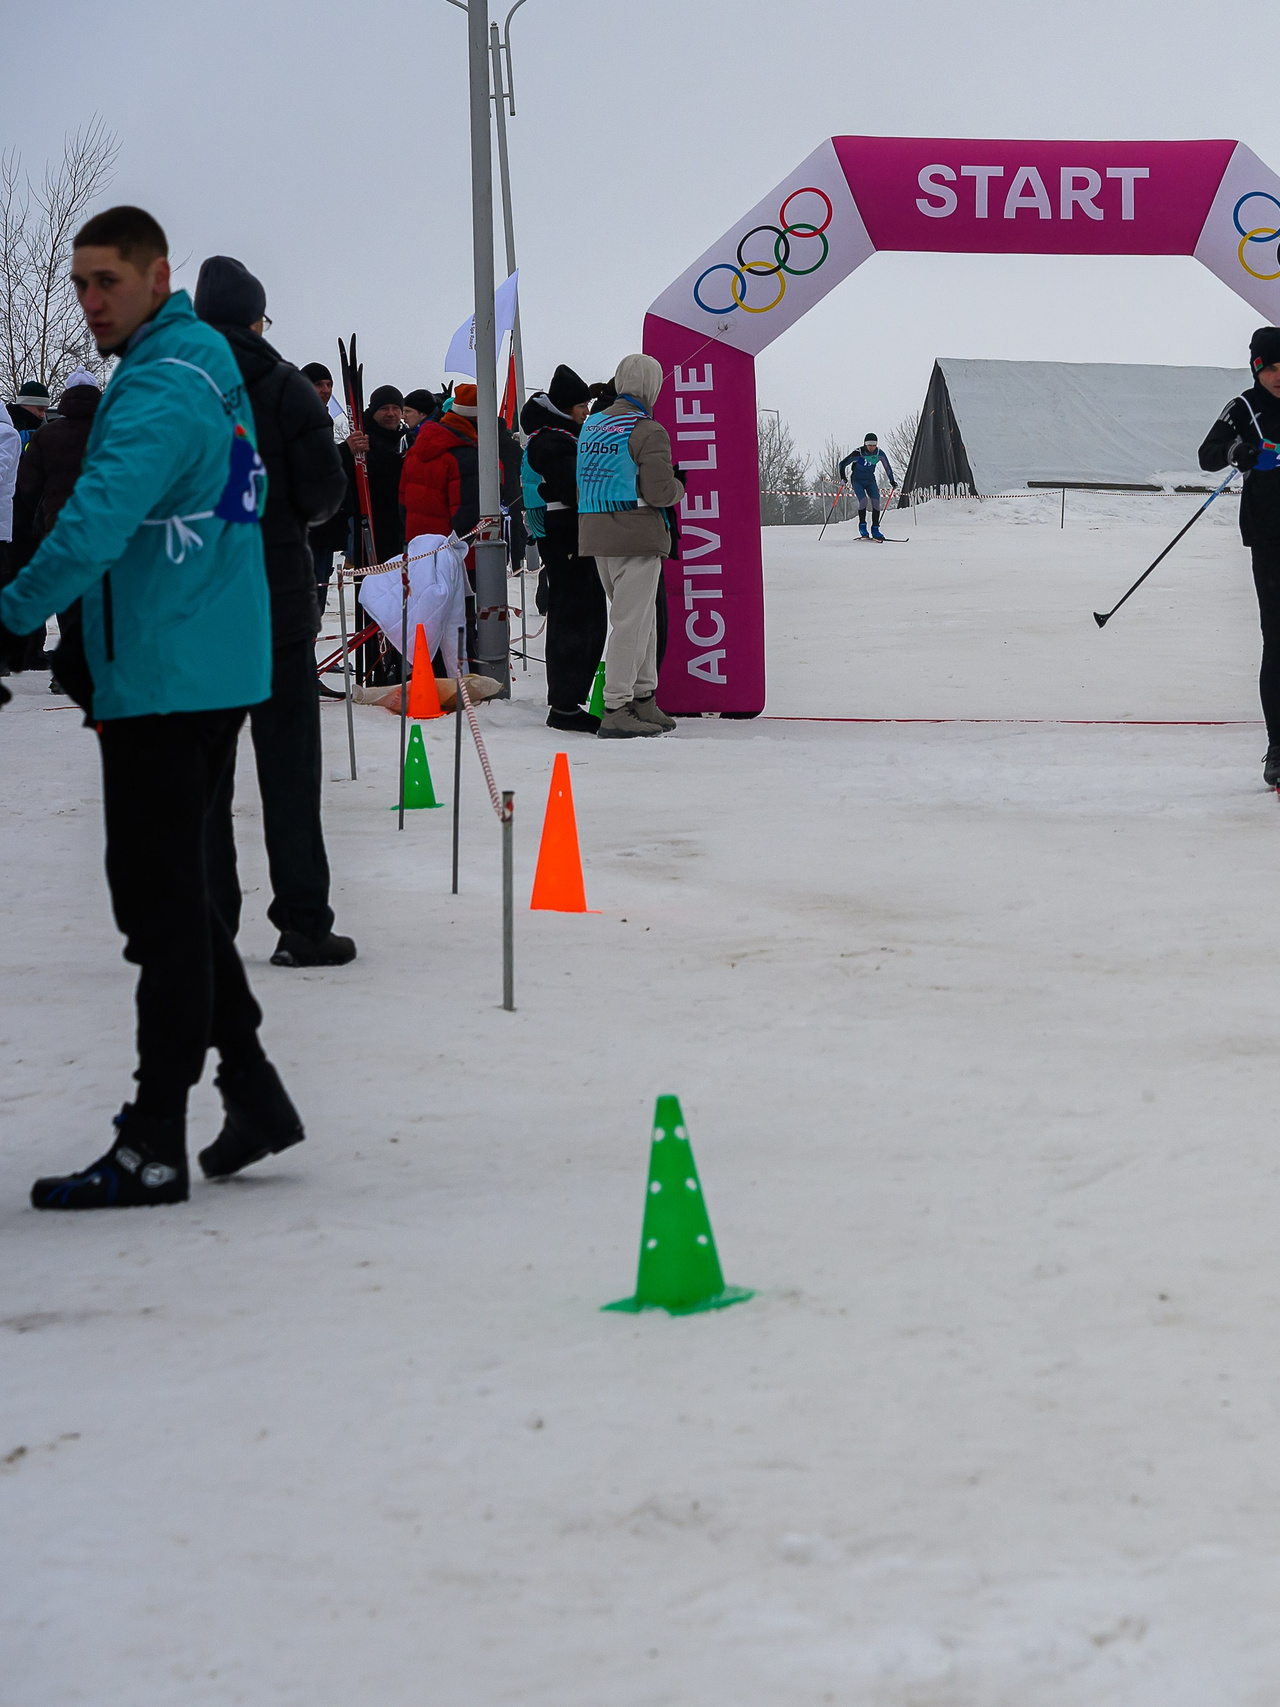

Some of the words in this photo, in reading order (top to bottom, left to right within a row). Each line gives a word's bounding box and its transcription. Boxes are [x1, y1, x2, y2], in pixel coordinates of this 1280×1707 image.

[915, 163, 1150, 220] START
[579, 441, 619, 456] СУДЬЯ
[673, 363, 717, 470] LIFE
[680, 490, 727, 684] ACTIVE
